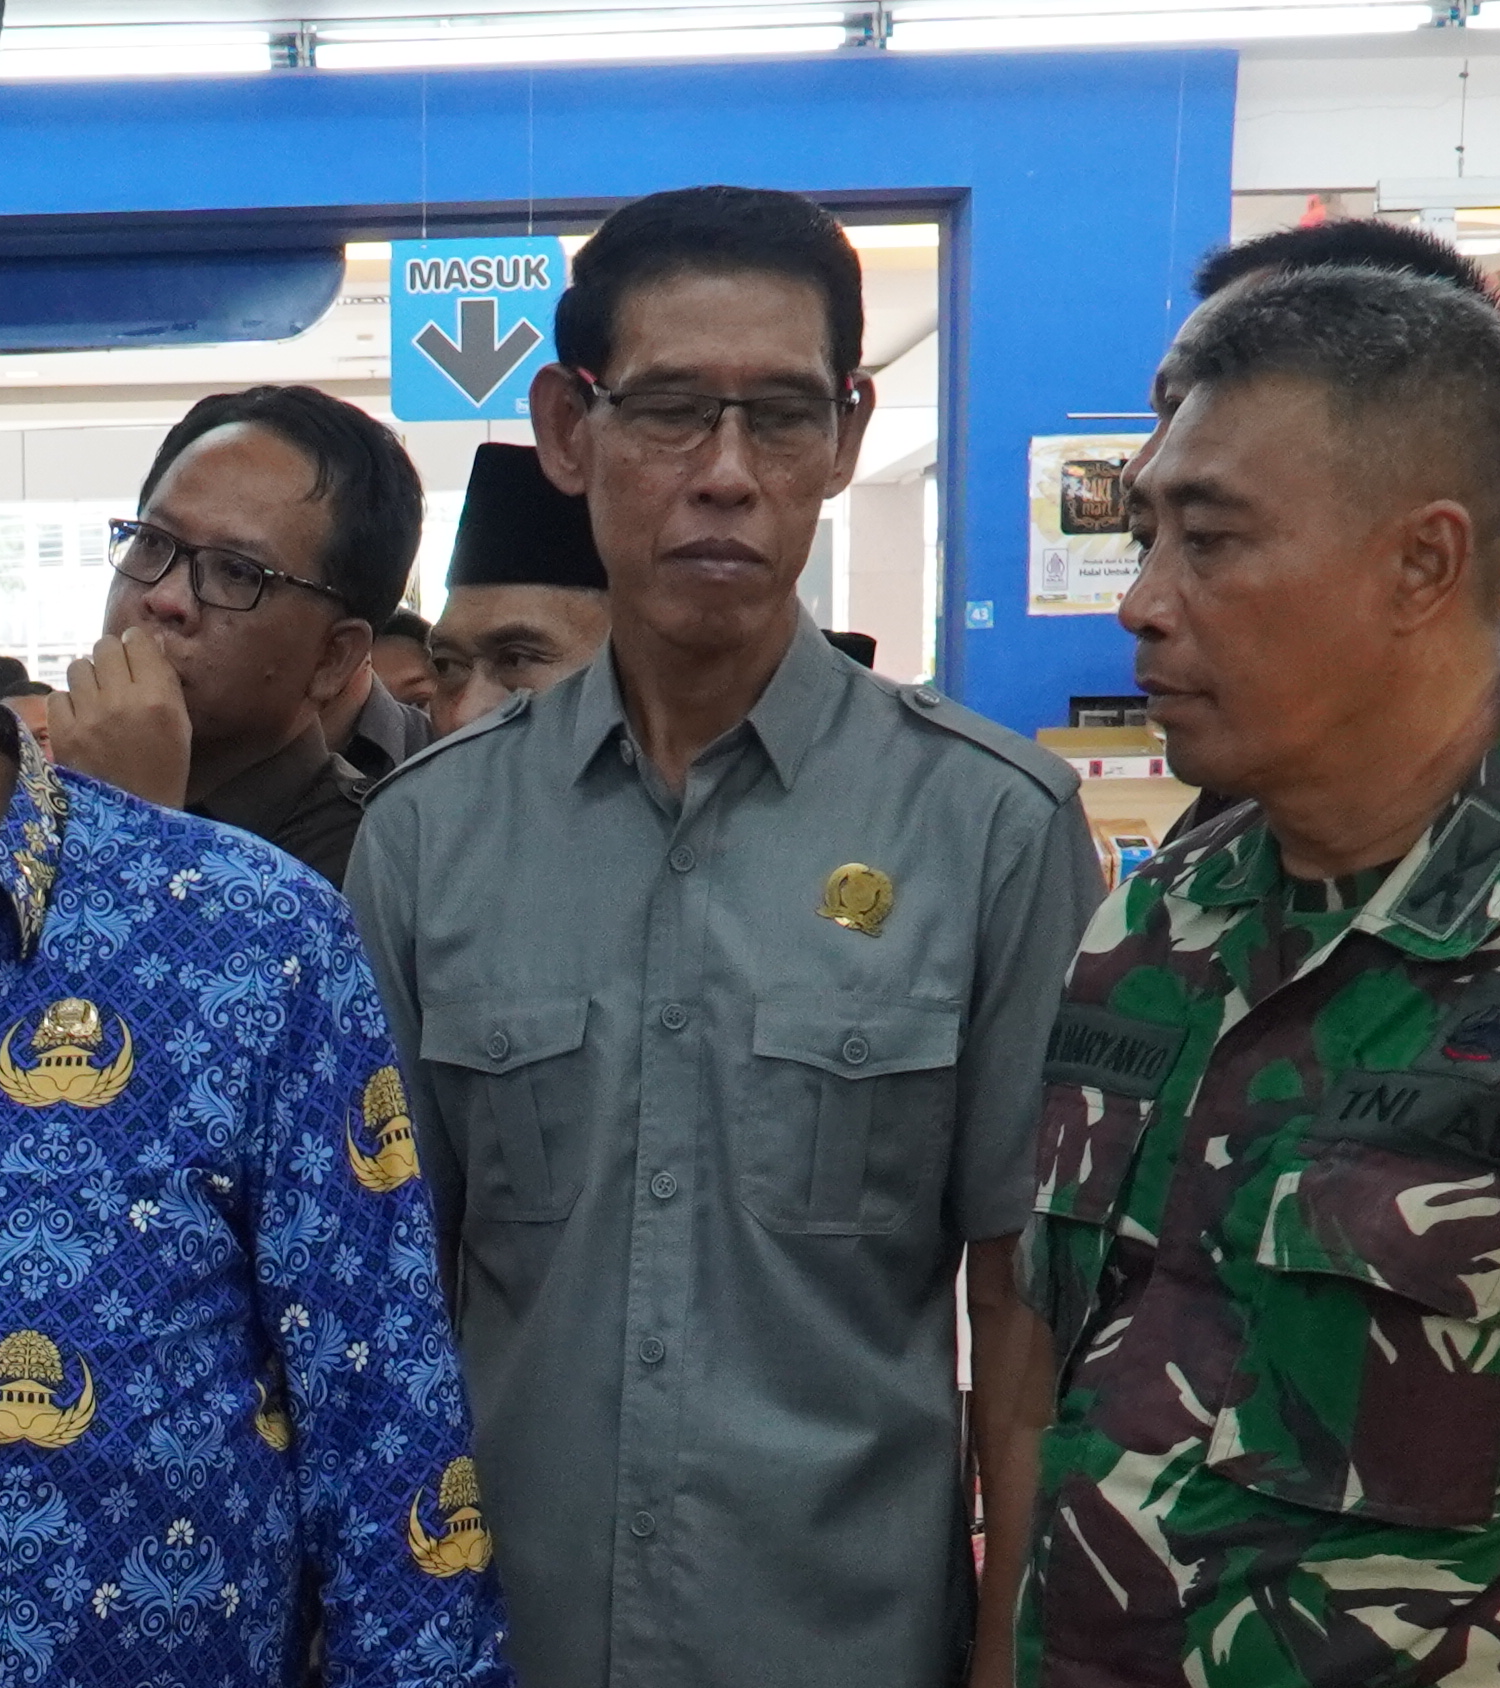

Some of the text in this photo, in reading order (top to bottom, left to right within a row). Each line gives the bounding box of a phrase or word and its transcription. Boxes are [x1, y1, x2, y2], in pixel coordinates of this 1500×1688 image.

[408, 257, 549, 292] MASUK
[1079, 568, 1101, 577] Halal
[971, 607, 988, 620] 43
[1340, 1086, 1422, 1126] TNI
